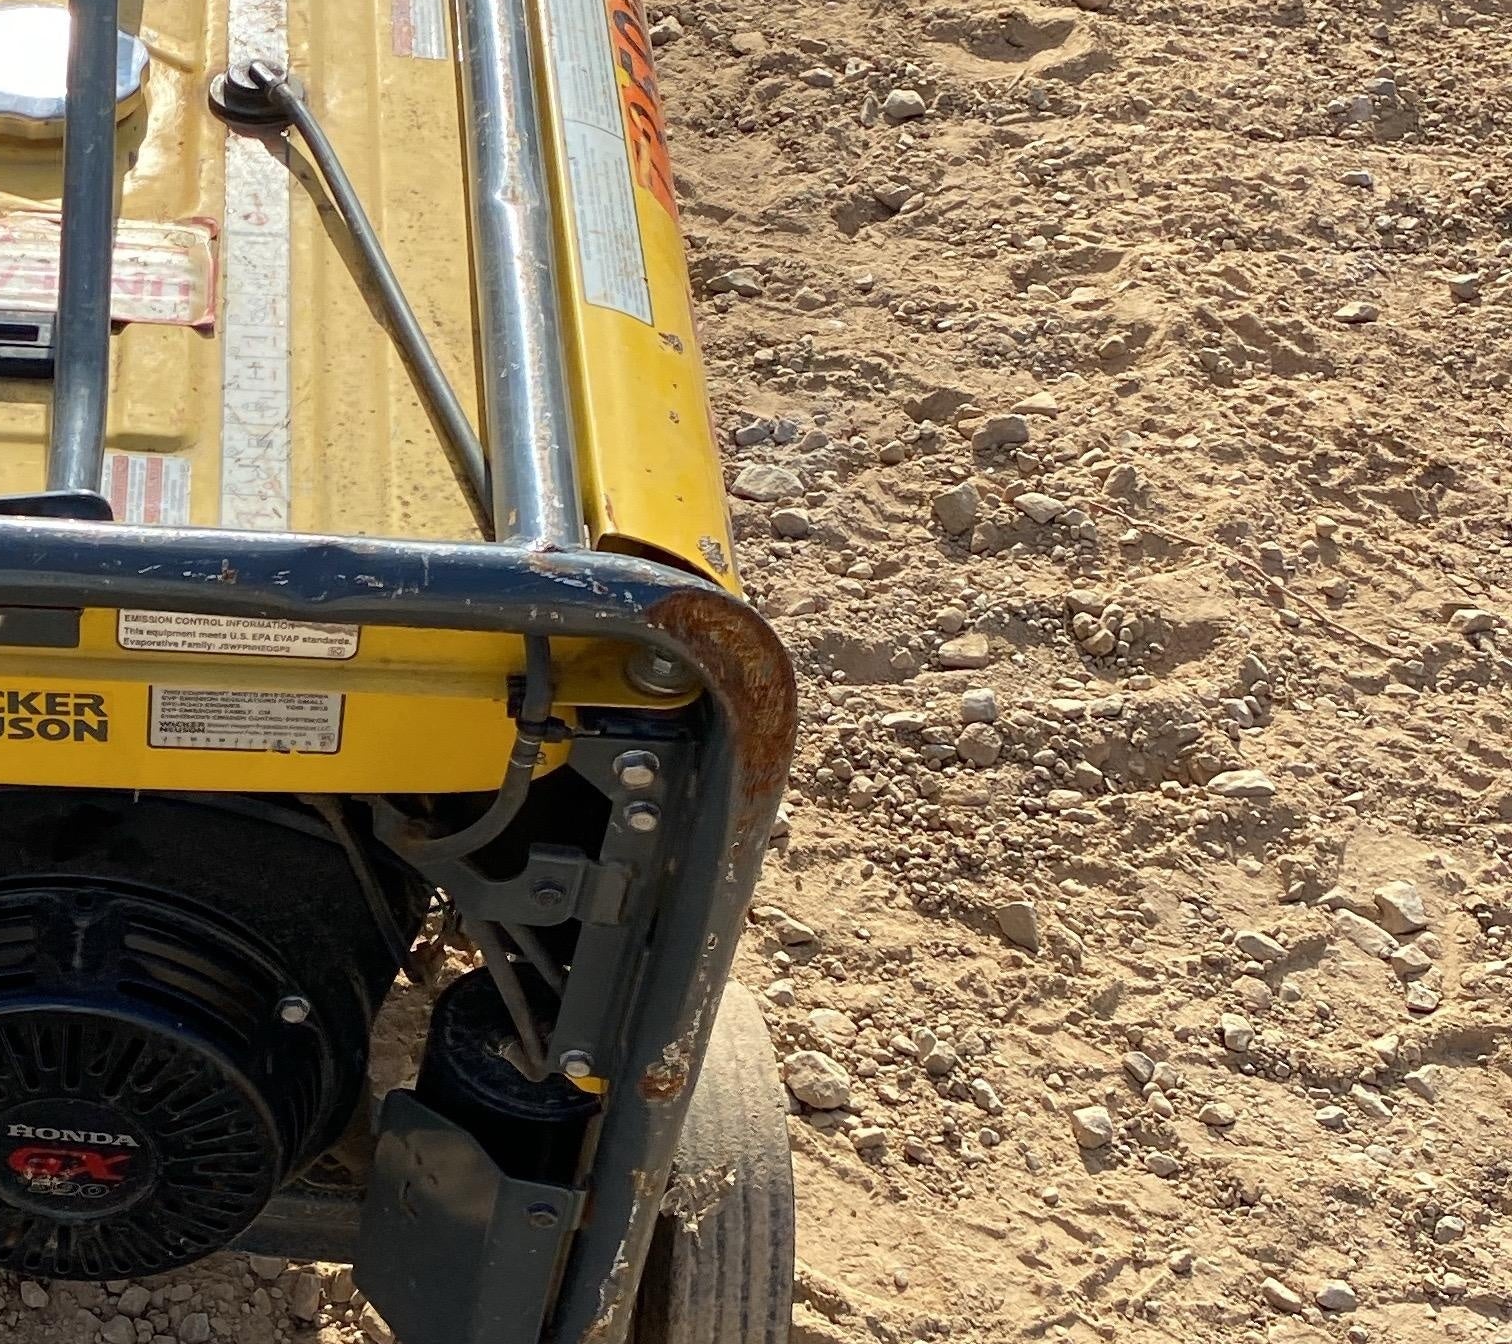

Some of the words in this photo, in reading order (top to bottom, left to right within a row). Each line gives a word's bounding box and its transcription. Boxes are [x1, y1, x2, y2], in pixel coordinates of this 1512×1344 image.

[124, 614, 172, 624] EMISSION
[175, 616, 224, 627] CONTROL
[124, 627, 144, 636] This
[146, 629, 196, 639] equipment
[199, 631, 227, 640] meets
[229, 632, 248, 641] U.S.
[252, 633, 271, 642] EPA
[273, 634, 299, 643] EVAP
[302, 636, 352, 645] standards.
[124, 637, 179, 649] Evaporative
[7, 1124, 141, 1148] HONDA
[8, 1147, 132, 1181] GX
